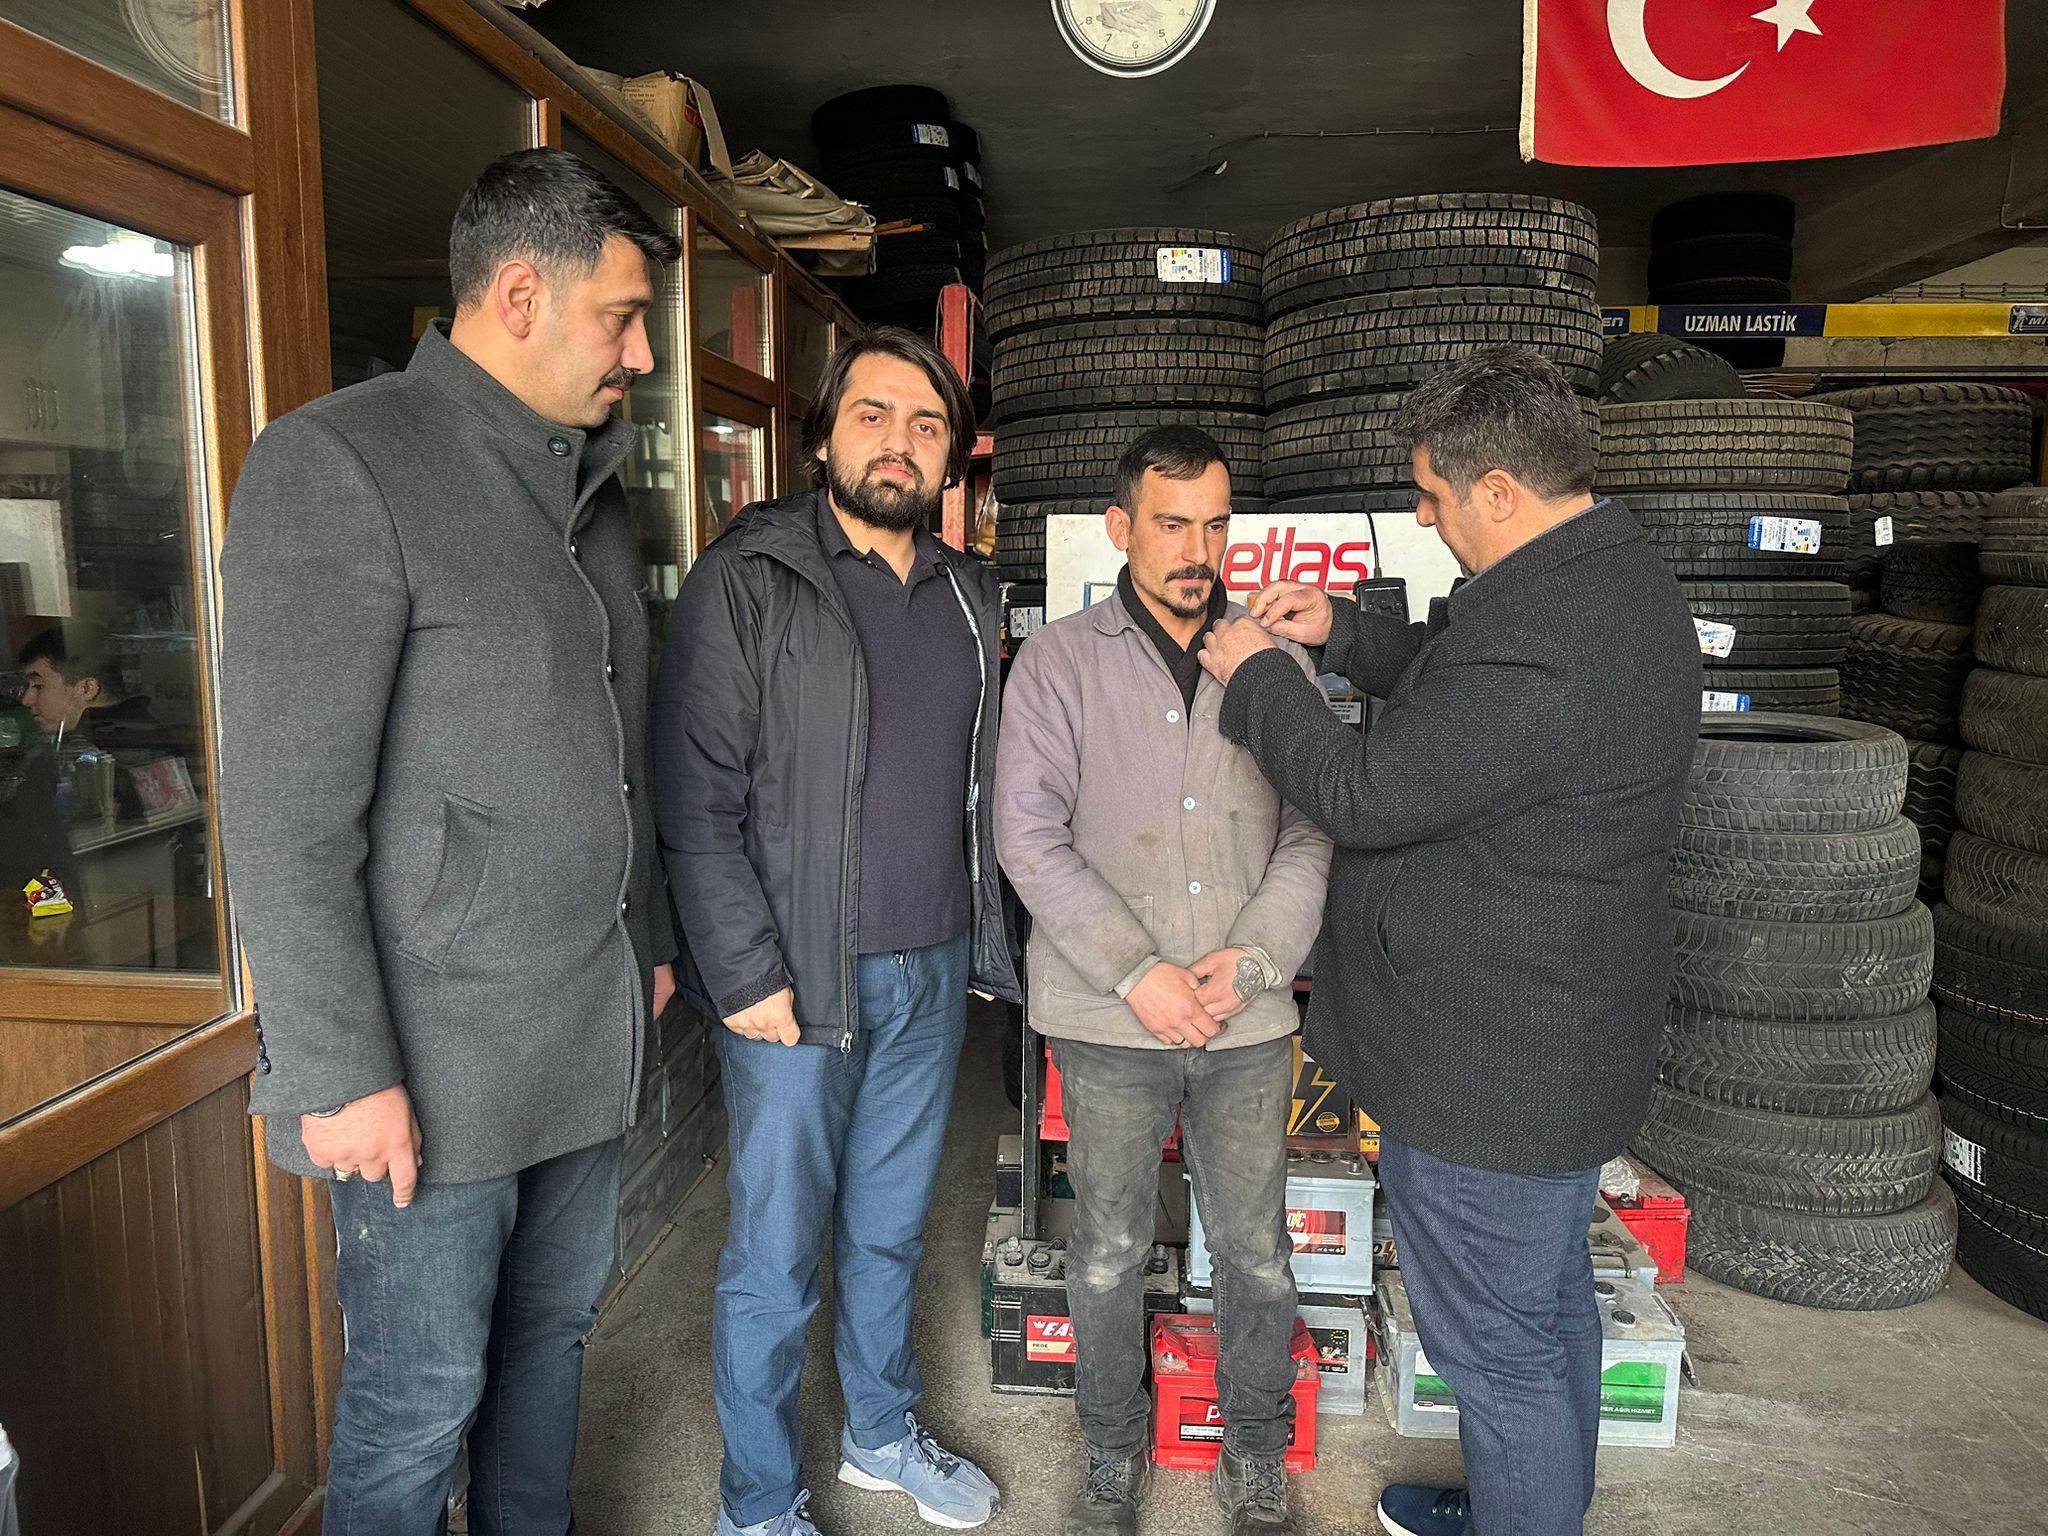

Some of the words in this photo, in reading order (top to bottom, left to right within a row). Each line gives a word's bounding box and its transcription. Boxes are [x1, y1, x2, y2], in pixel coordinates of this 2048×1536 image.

[1178, 8, 1185, 17] 4
[1085, 17, 1093, 25] 8
[1105, 33, 1112, 43] 7
[1158, 29, 1166, 38] 5
[1132, 40, 1139, 49] 6
[1684, 314, 1742, 333] UZMAN
[1745, 309, 1798, 333] LASTİK
[2028, 316, 2048, 325] MI
[1205, 1405, 1221, 1423] P
